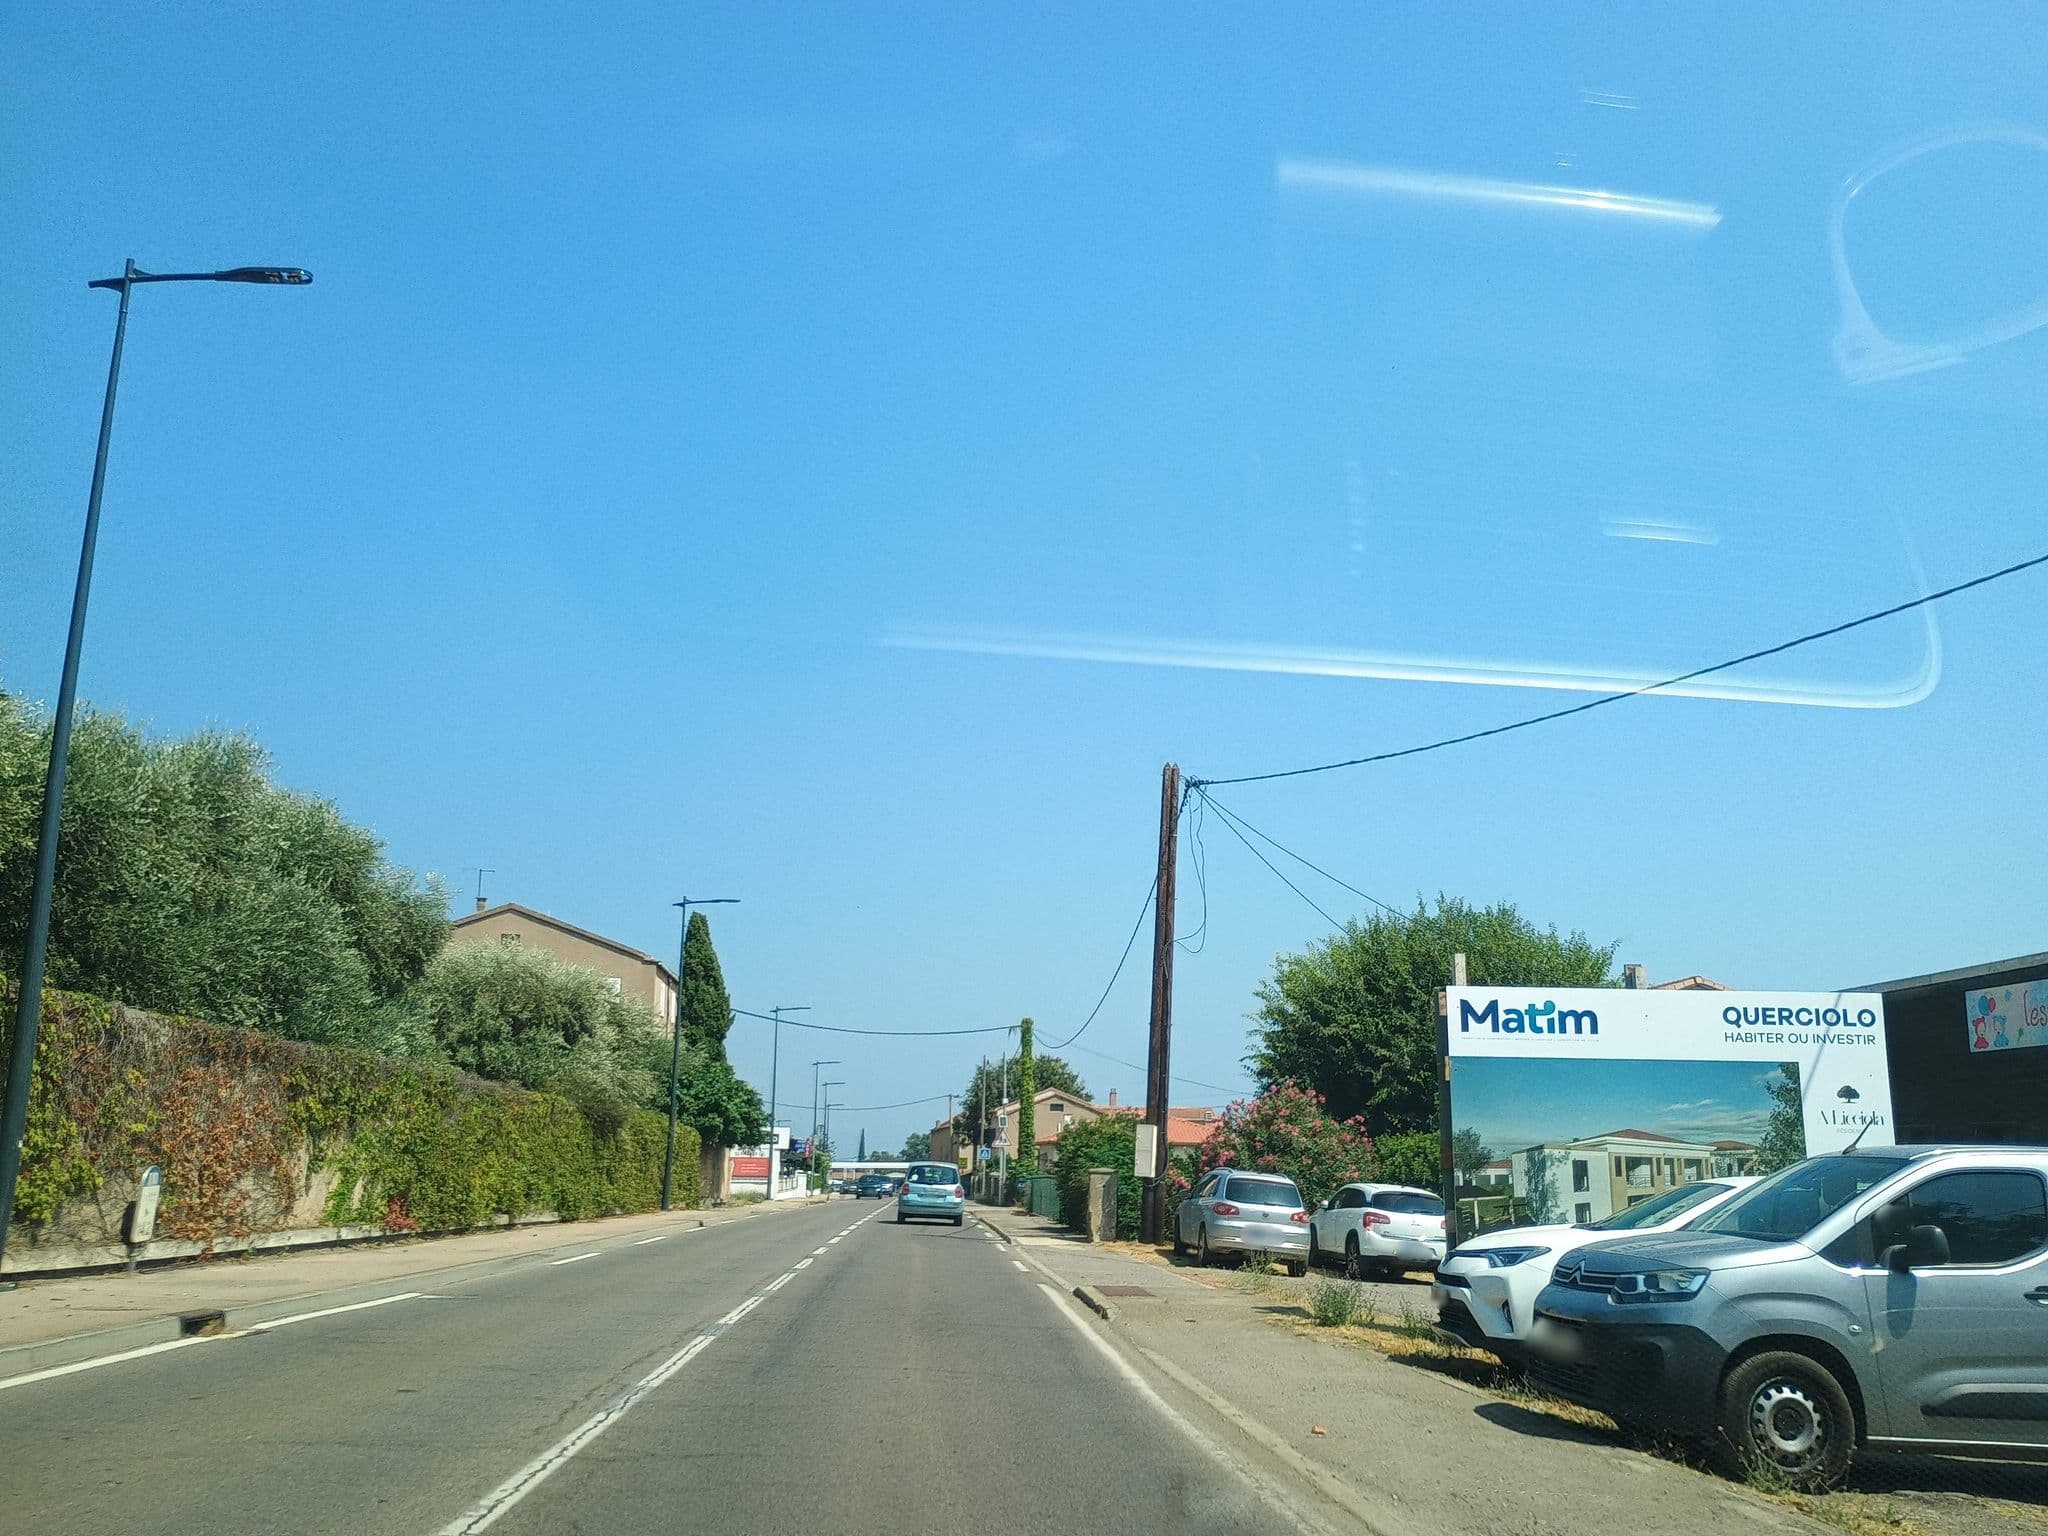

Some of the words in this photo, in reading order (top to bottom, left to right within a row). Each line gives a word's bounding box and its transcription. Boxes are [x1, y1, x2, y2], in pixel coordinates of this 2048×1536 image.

[1459, 998, 1599, 1035] Matim
[1722, 1006, 1877, 1029] QUERCIOLO
[1724, 1031, 1784, 1044] HABITER
[1788, 1032, 1809, 1045] OU
[1812, 1033, 1877, 1046] INVESTIR
